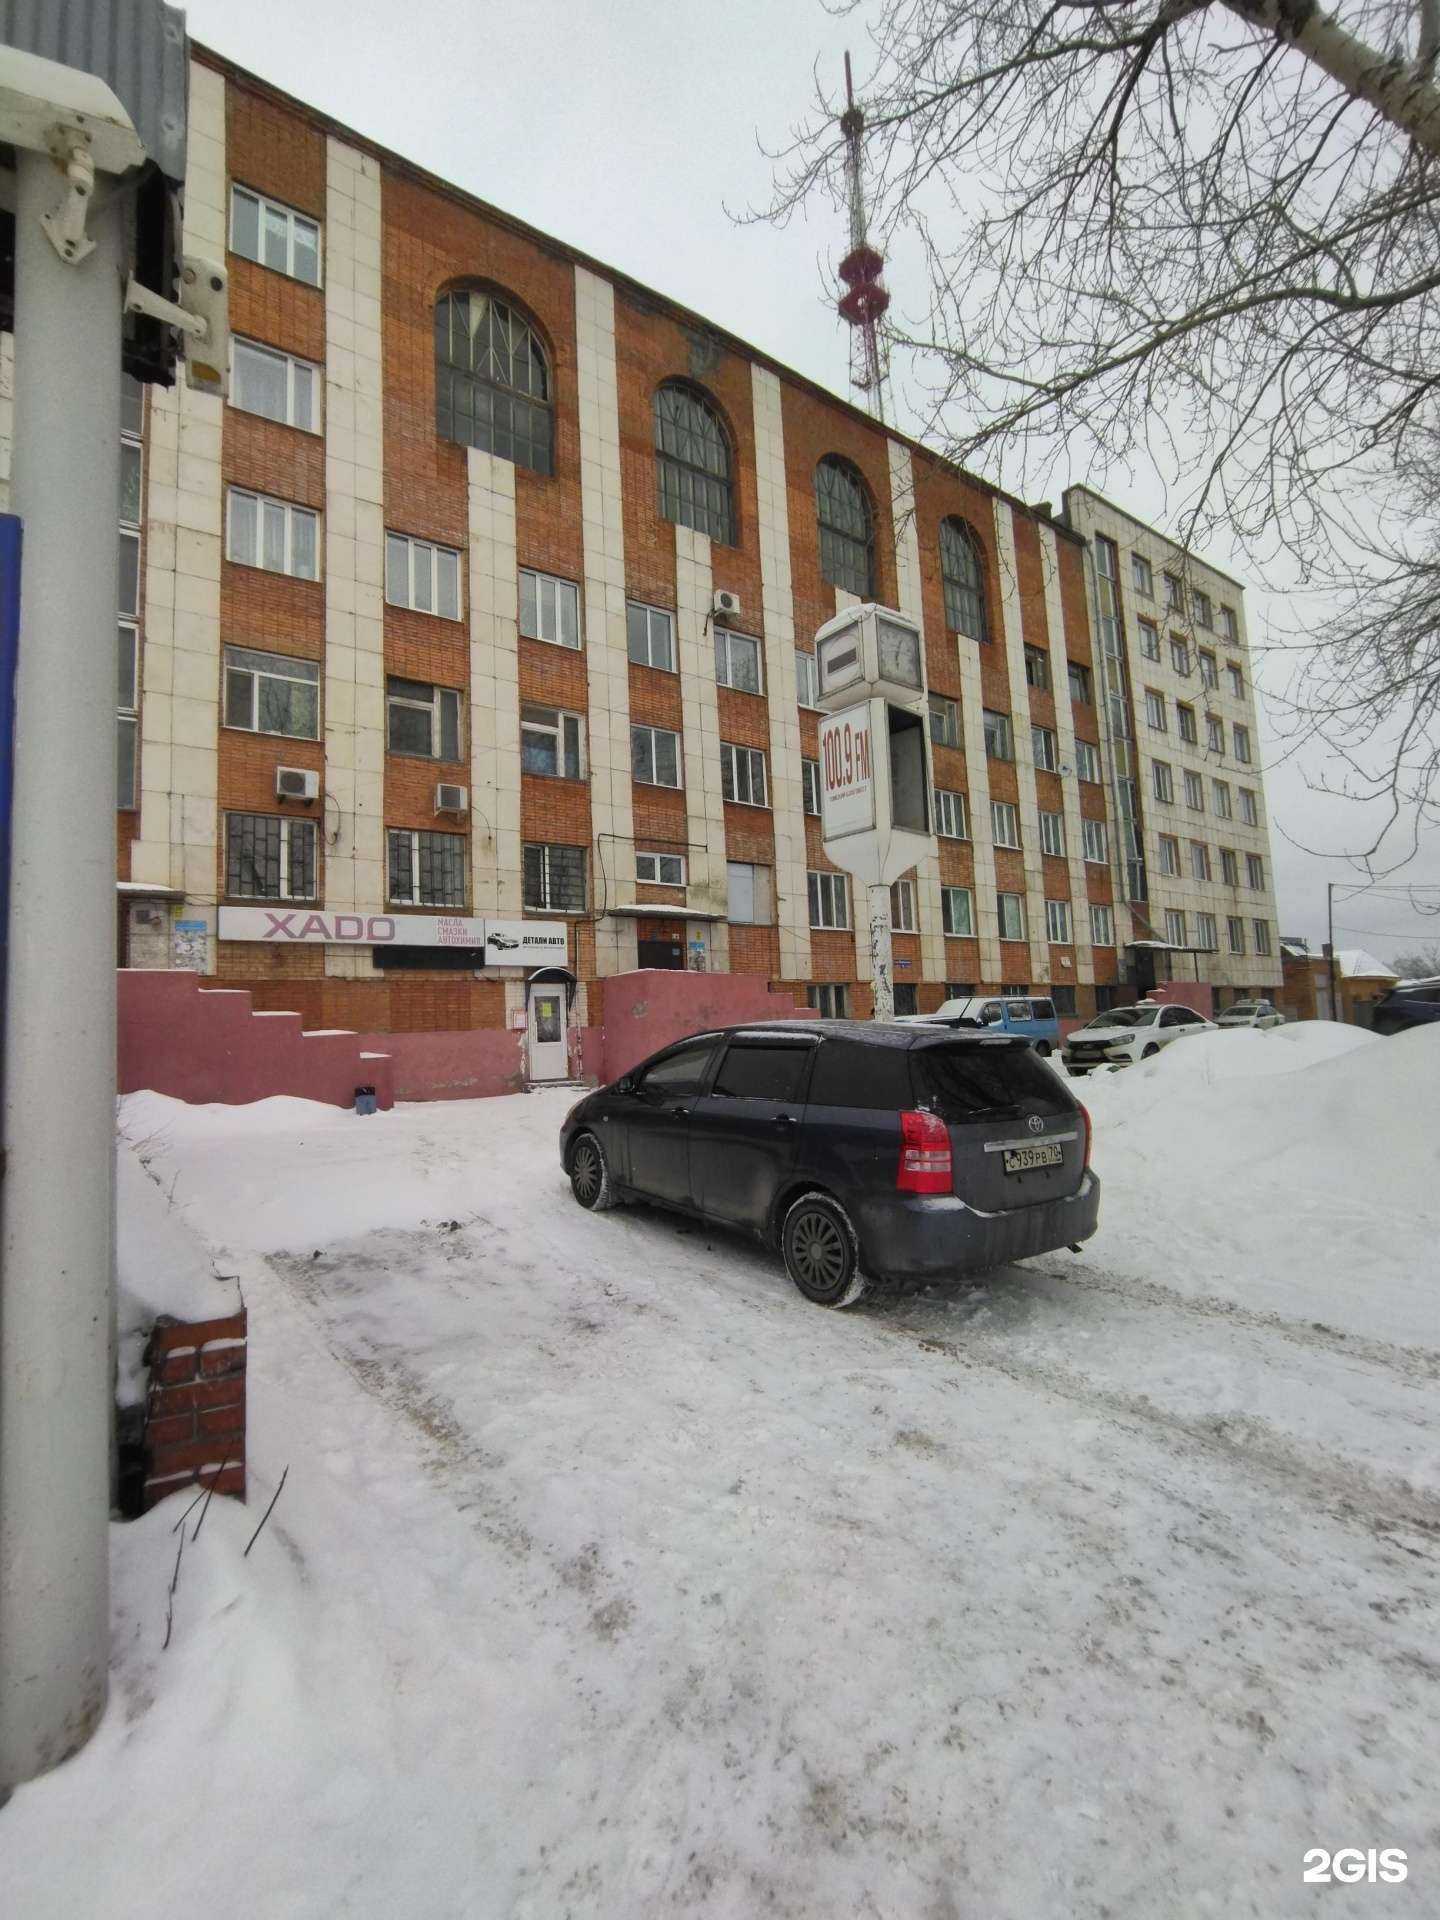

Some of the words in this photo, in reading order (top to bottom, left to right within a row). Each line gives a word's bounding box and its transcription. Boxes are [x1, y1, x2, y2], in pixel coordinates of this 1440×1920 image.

[823, 723, 852, 791] 100.9
[855, 729, 870, 782] FM
[263, 913, 395, 940] XADO
[437, 918, 463, 927] МАСЛА
[437, 927, 468, 936] СМАЗКИ
[522, 936, 548, 945] ДЕТАЛИ
[548, 936, 565, 945] АВТО
